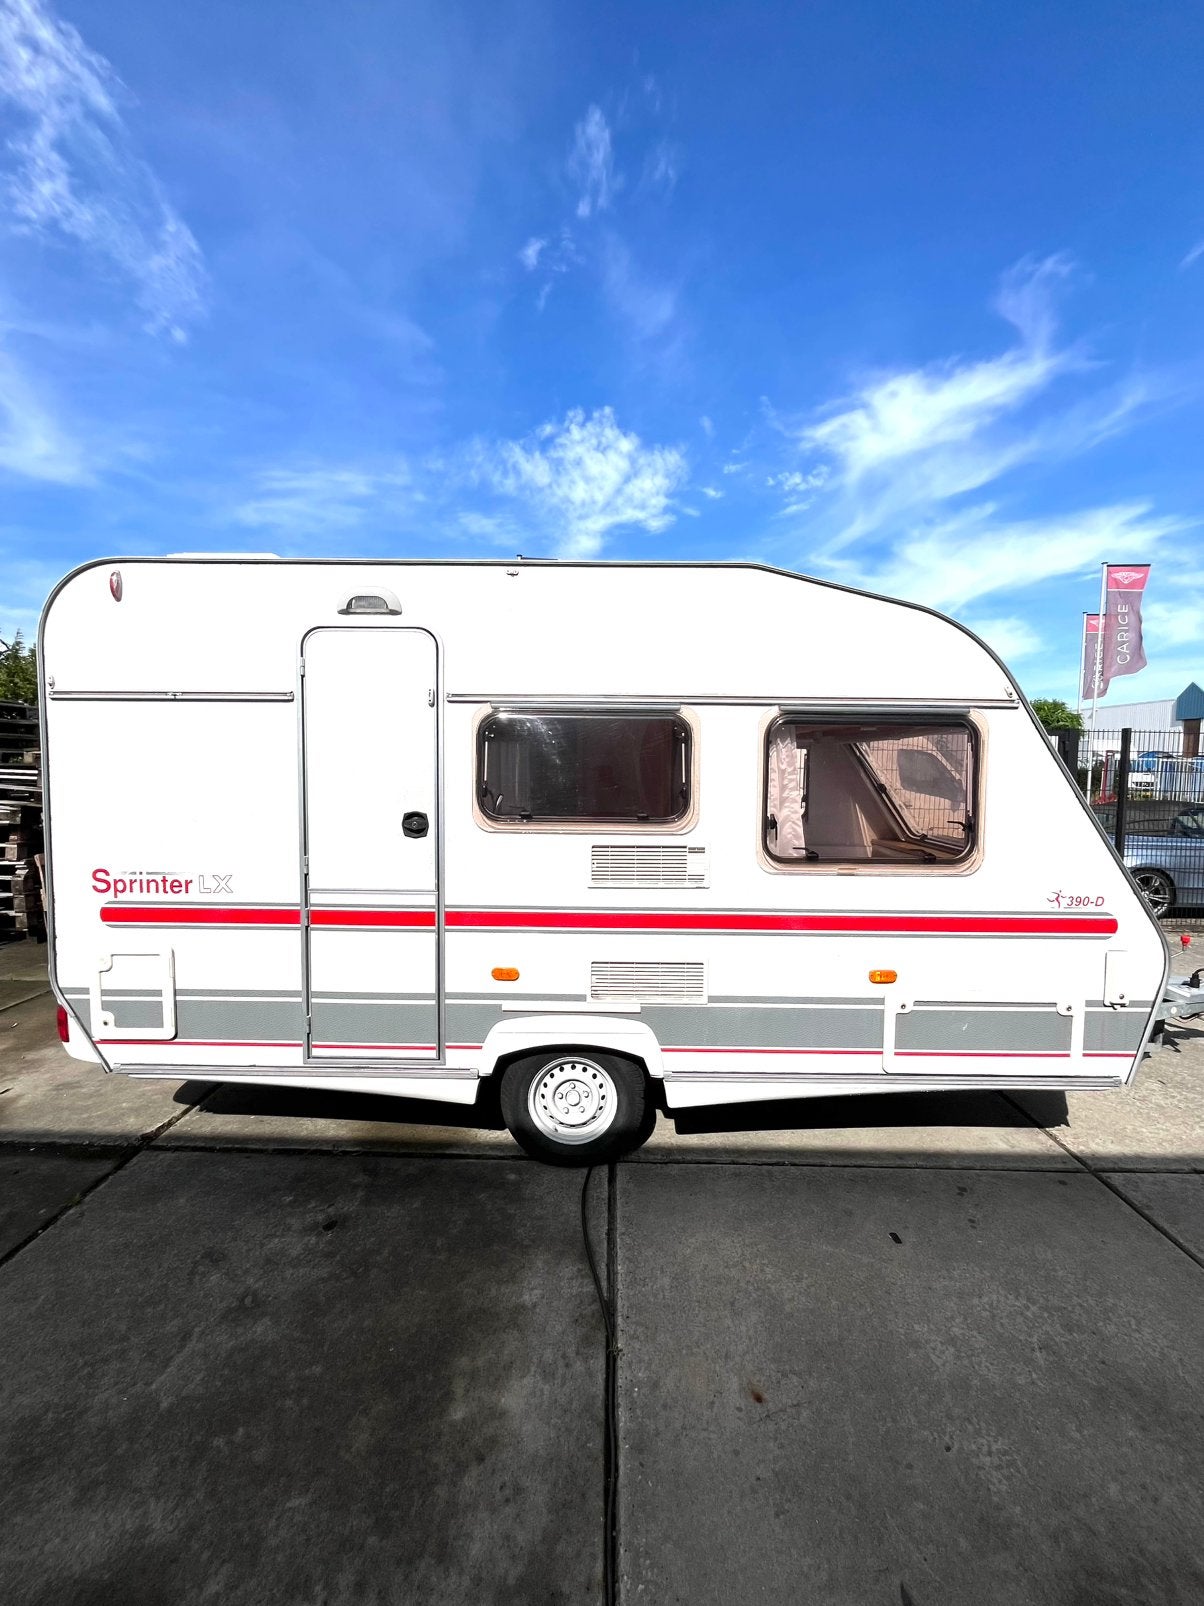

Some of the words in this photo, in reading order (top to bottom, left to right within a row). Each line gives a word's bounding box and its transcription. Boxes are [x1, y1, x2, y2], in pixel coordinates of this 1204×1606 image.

[1116, 604, 1130, 665] CARICE
[92, 868, 192, 898] Sprinter
[198, 874, 234, 894] LX
[1066, 896, 1105, 907] 390-D
